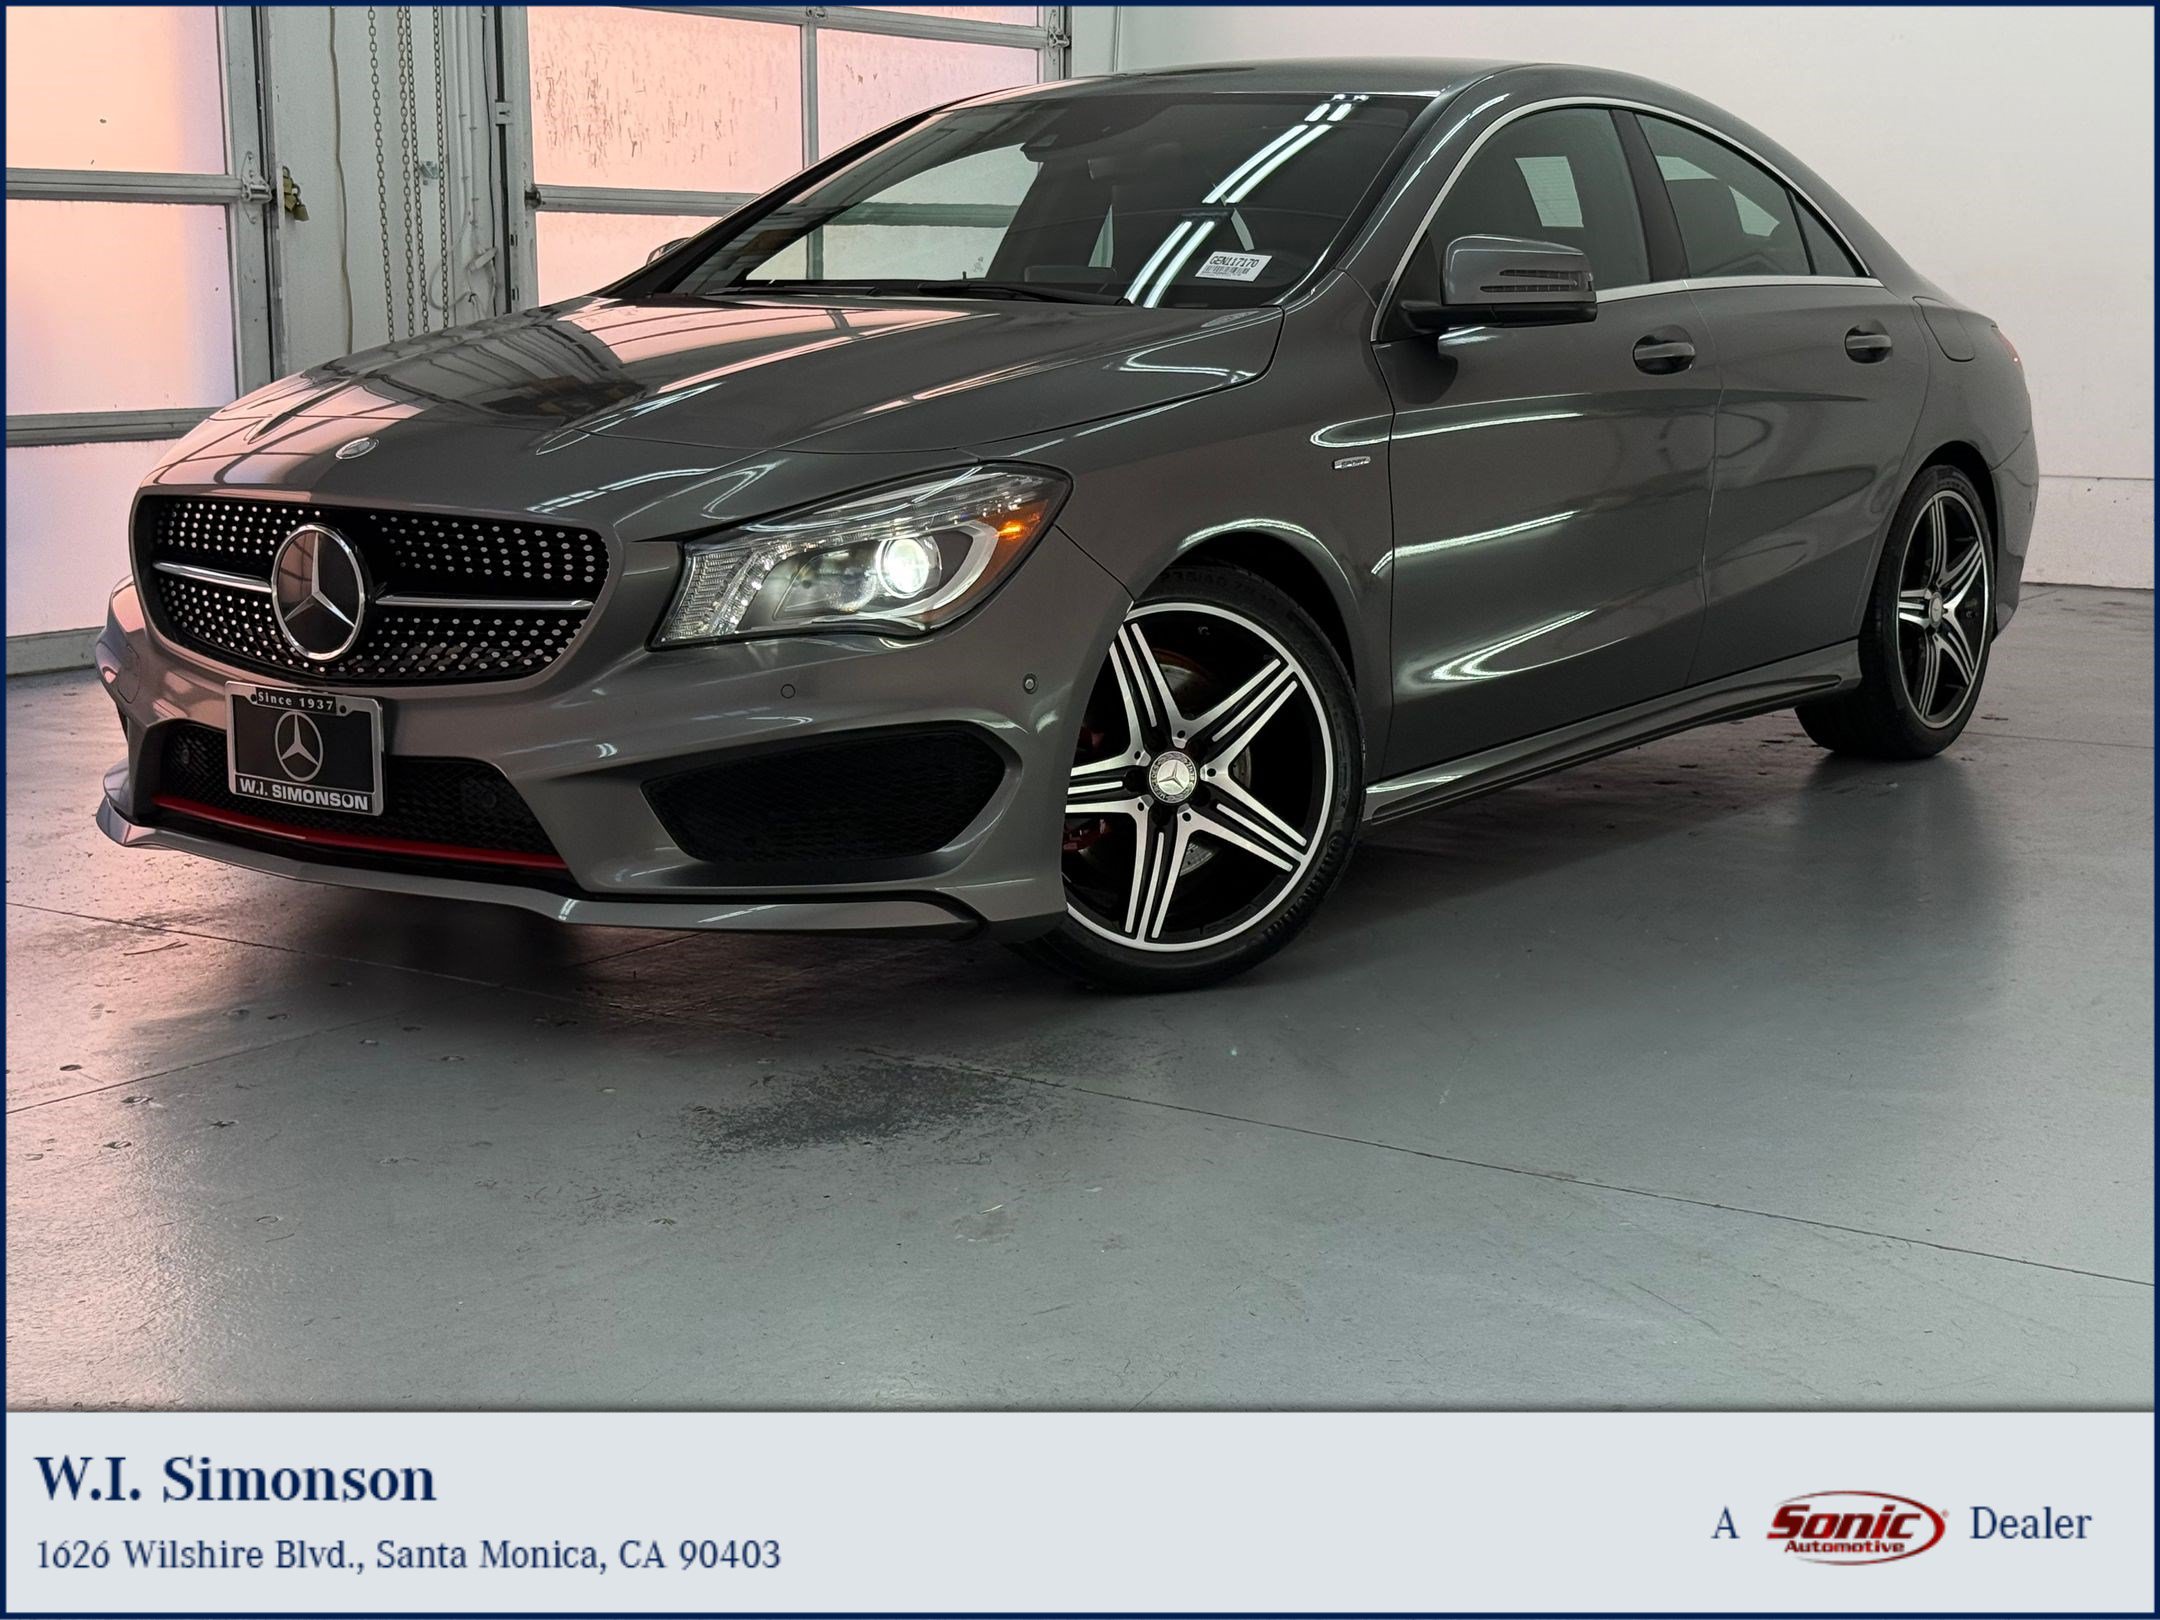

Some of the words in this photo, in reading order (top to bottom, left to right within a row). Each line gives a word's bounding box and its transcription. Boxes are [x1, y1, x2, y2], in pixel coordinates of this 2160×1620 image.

[1209, 255, 1261, 268] GEN117170
[258, 691, 293, 706] Since
[299, 698, 334, 711] 1937
[240, 778, 268, 796] W.I.
[272, 784, 368, 811] SIMONSON
